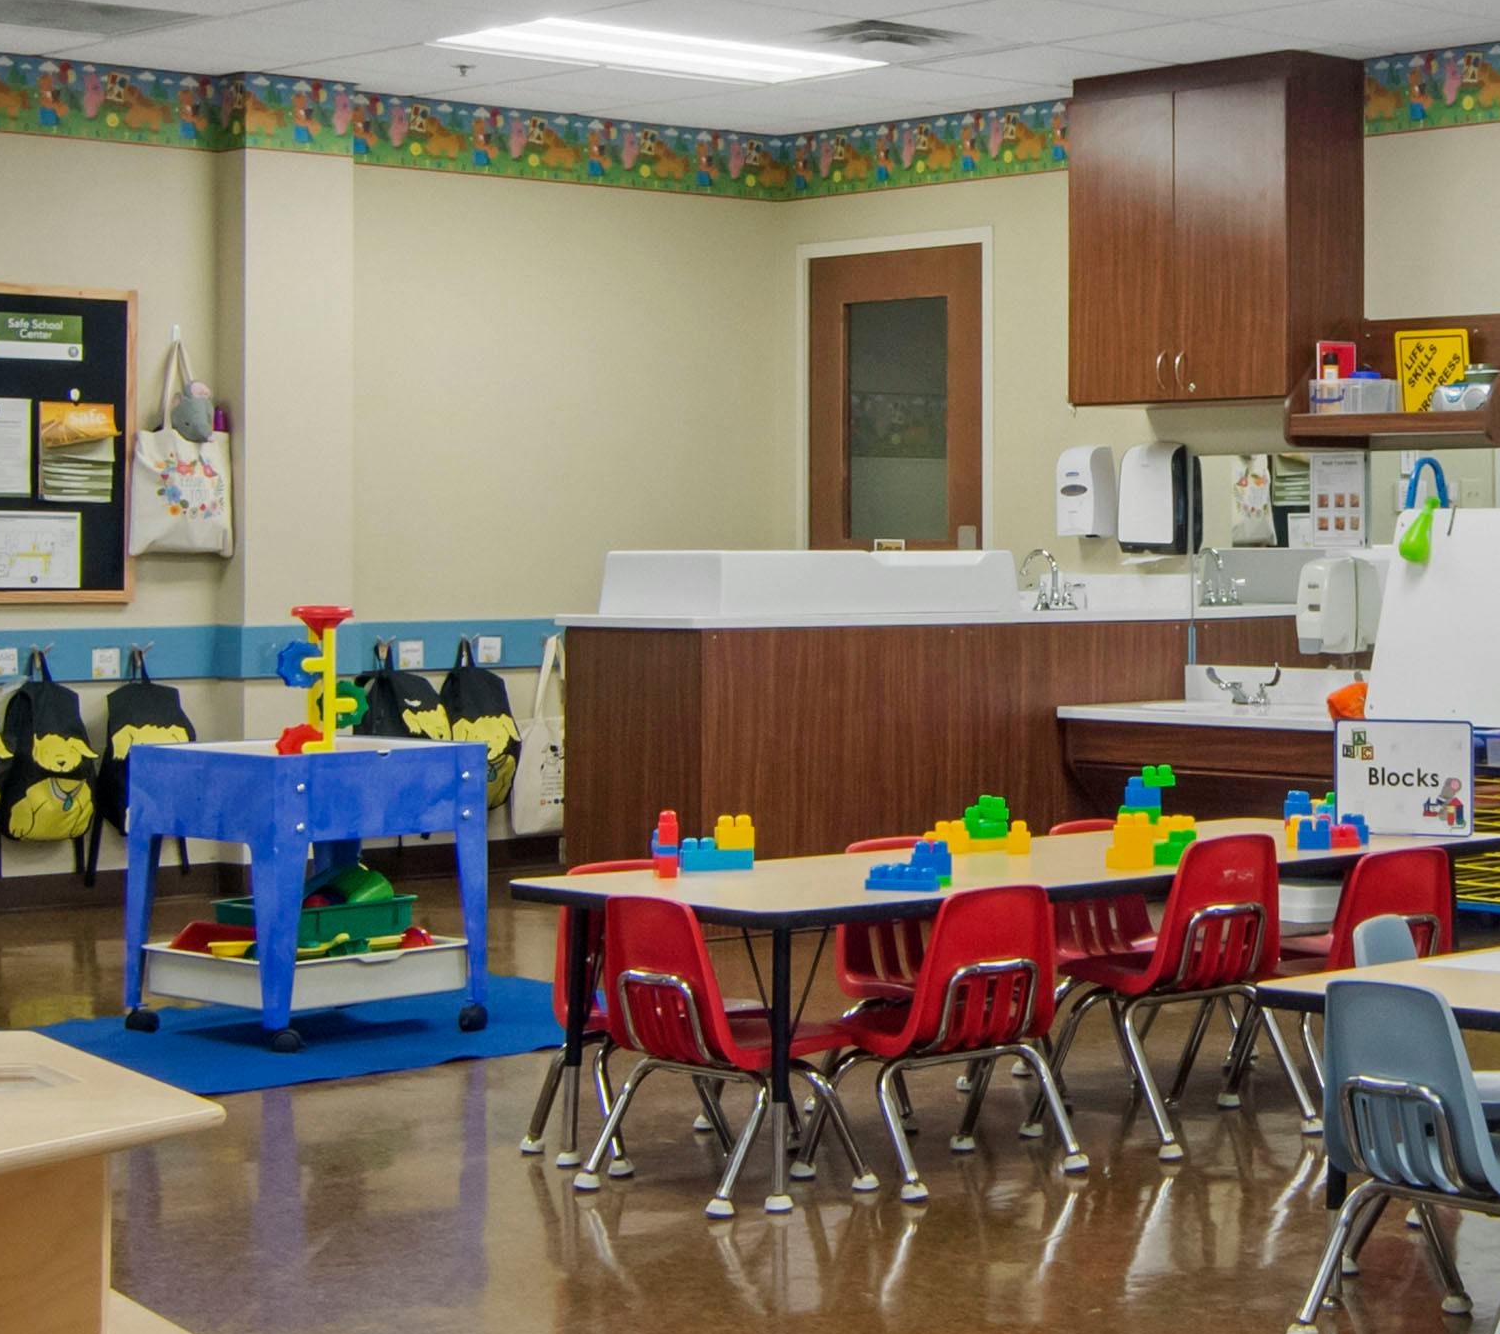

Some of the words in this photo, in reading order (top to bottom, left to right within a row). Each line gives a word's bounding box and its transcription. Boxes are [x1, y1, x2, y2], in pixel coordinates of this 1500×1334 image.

[7, 318, 30, 329] Safe
[32, 319, 64, 331] School
[19, 328, 53, 340] Center
[1404, 342, 1425, 371] LIFE
[1408, 344, 1438, 388] SKILLS
[1425, 368, 1437, 385] IN
[1368, 767, 1440, 788] Blocks
